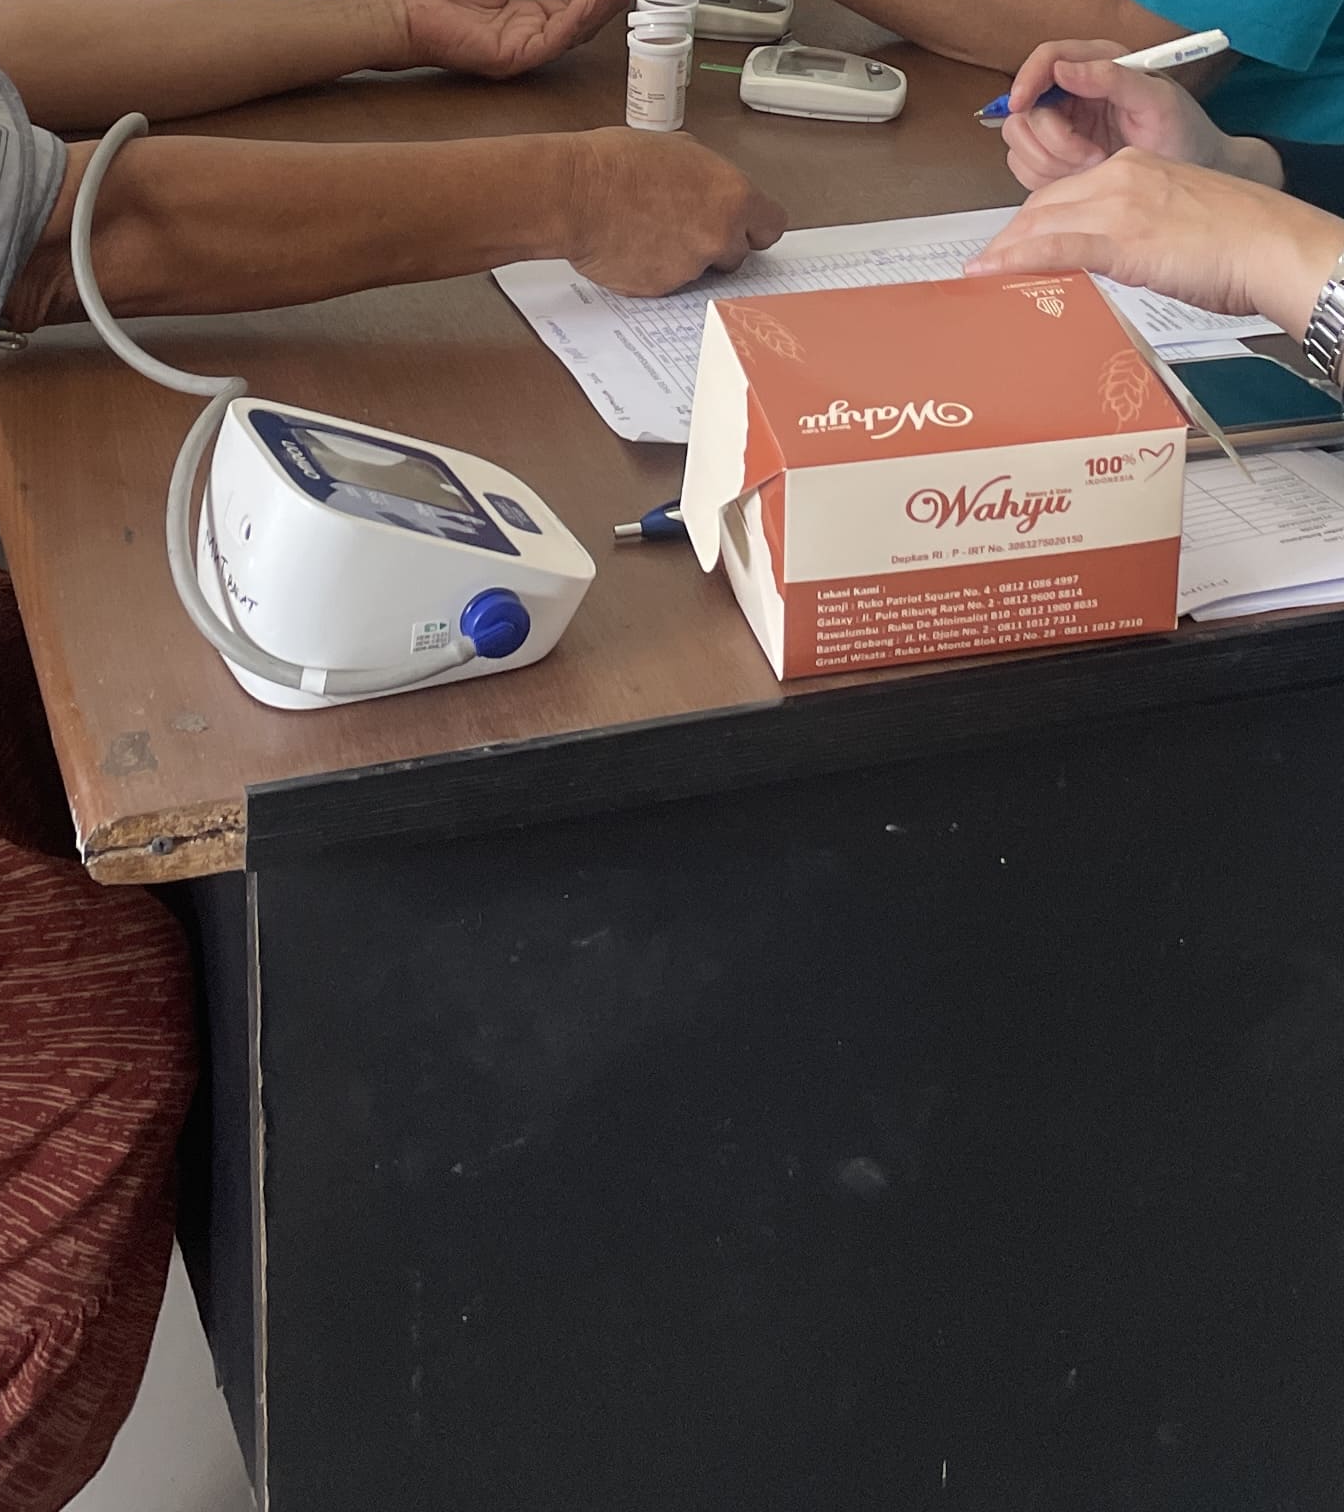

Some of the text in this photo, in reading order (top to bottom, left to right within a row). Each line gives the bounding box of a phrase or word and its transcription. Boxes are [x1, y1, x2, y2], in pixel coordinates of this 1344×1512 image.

[1020, 288, 1066, 298] HALAL
[798, 399, 974, 440] Wahyu
[1085, 453, 1136, 478] 100%
[905, 475, 1072, 534] Wahyu
[817, 601, 849, 614] Kranji
[857, 599, 884, 609] Ruko
[886, 594, 922, 607] Patriot
[925, 590, 961, 603] Square
[963, 588, 981, 598] No.
[817, 615, 853, 628] Galaxy
[888, 622, 914, 633] Ruko
[815, 654, 848, 667] Grand
[894, 646, 921, 657] Ruko
